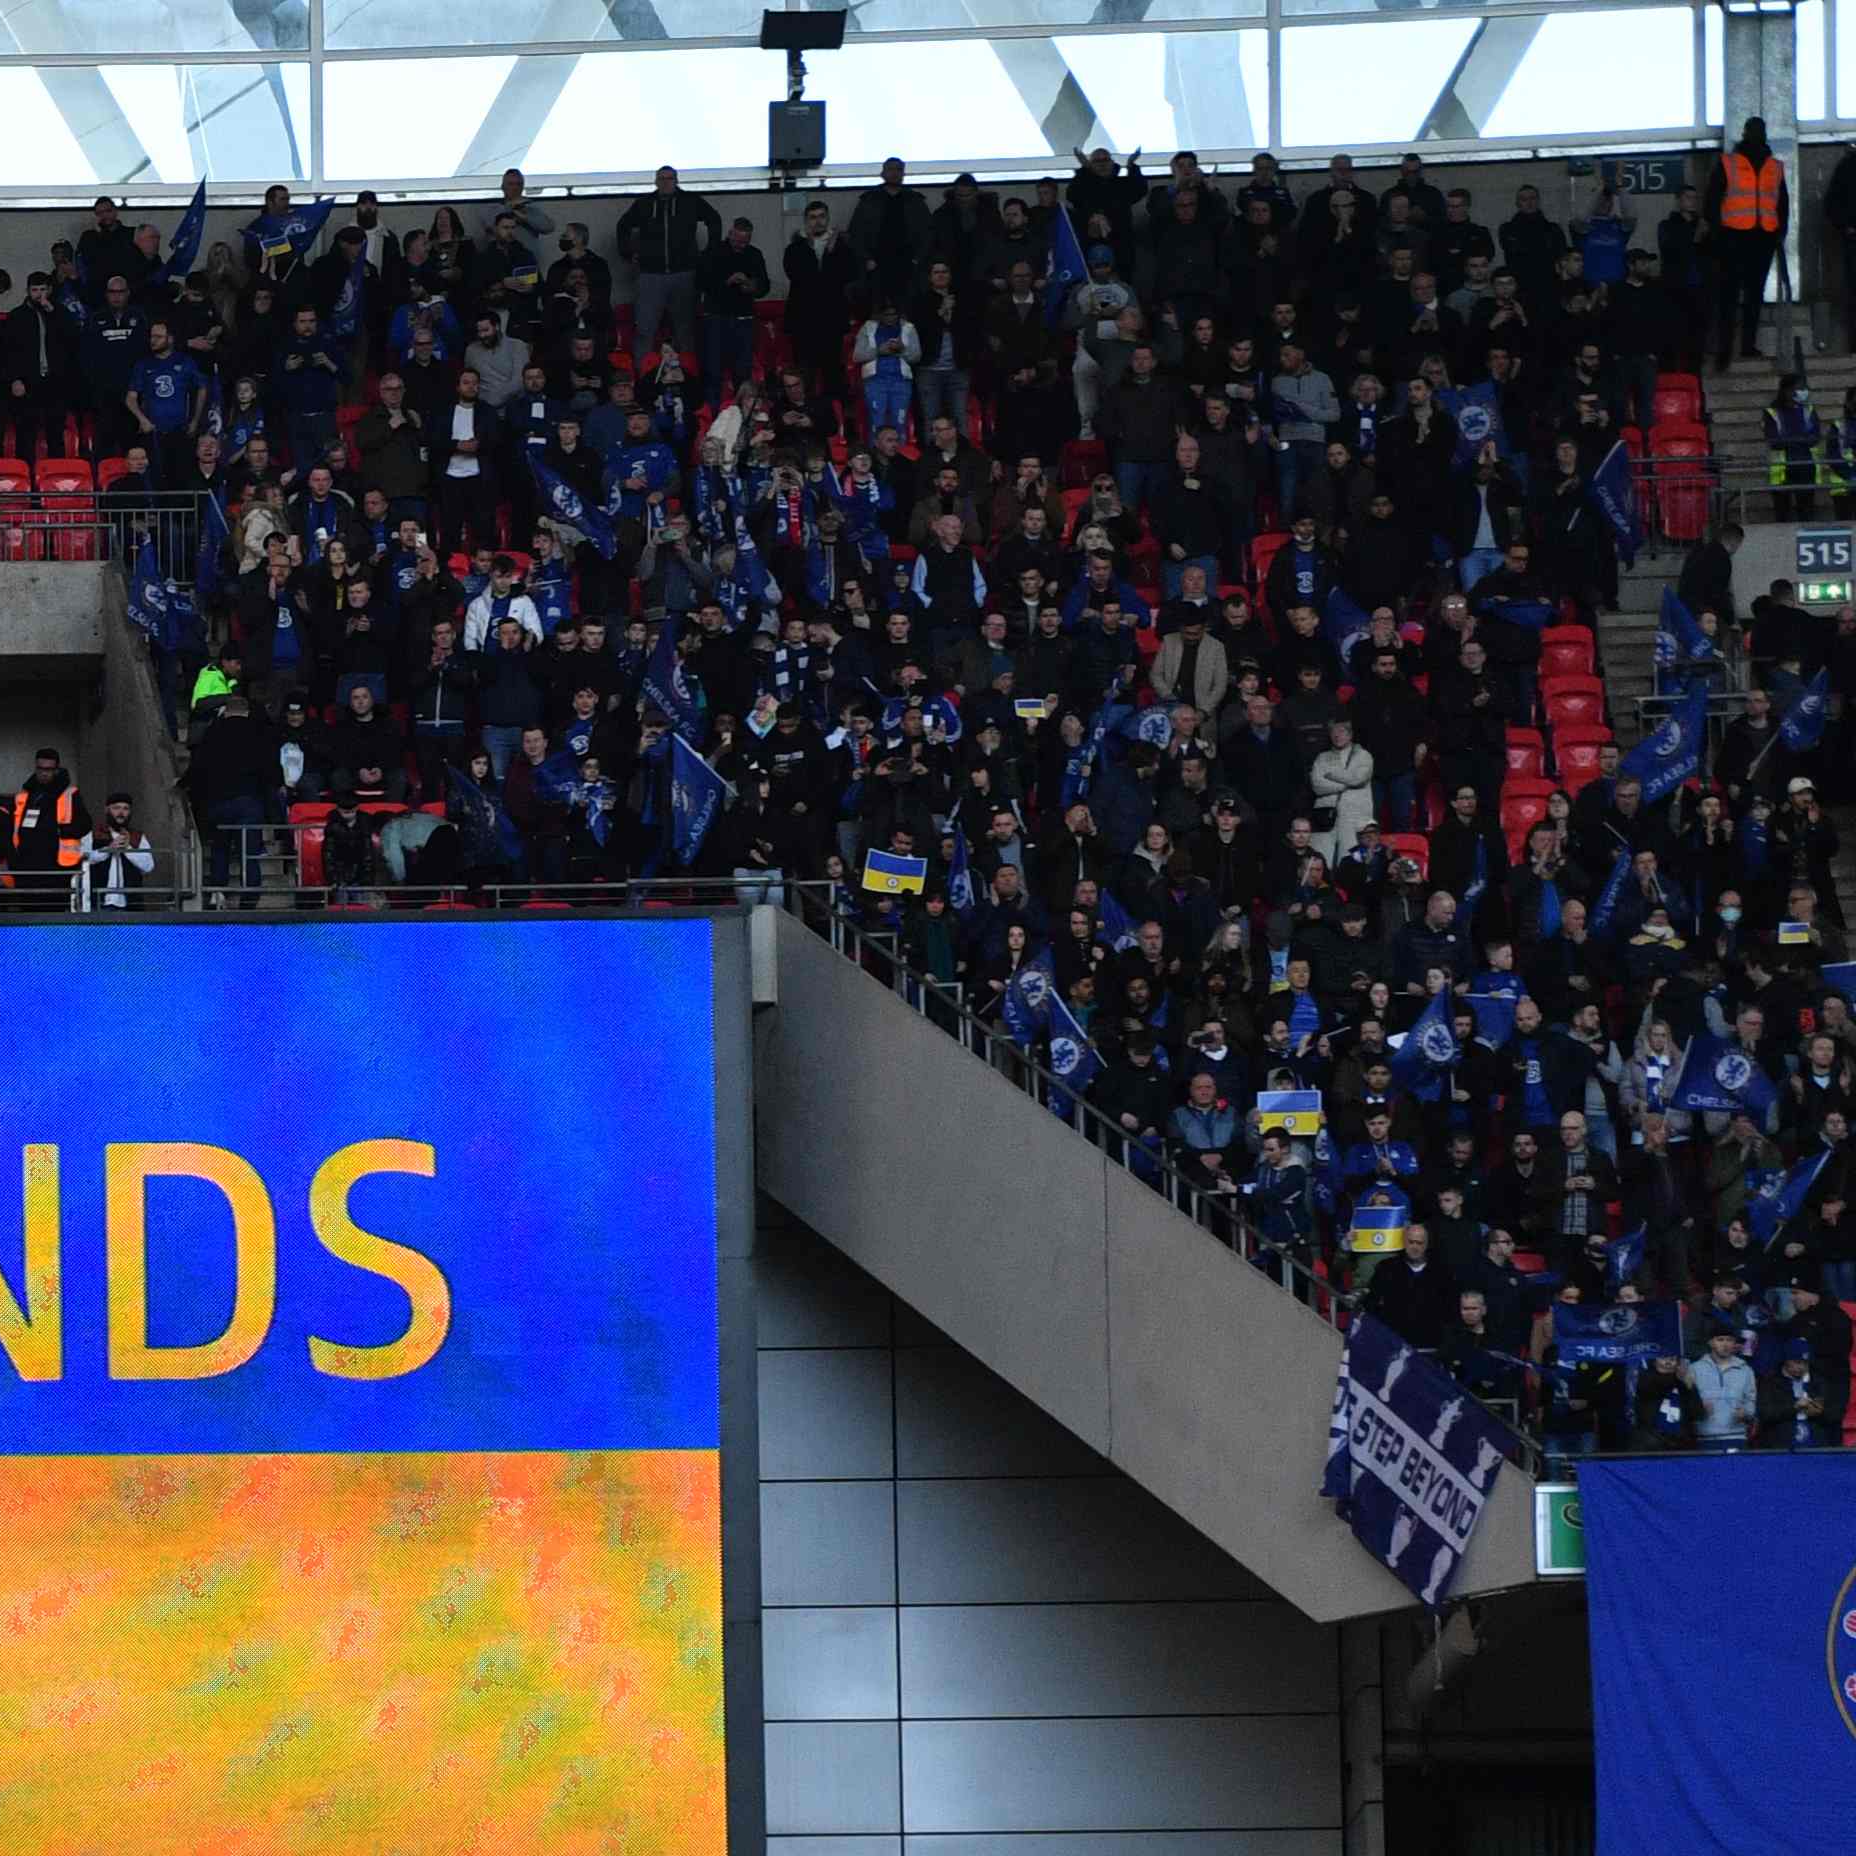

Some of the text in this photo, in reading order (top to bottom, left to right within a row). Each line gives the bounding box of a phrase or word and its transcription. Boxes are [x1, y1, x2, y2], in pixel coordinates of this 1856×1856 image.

[1799, 542, 1850, 566] 515
[1353, 1404, 1480, 1541] STEP BEYOND
